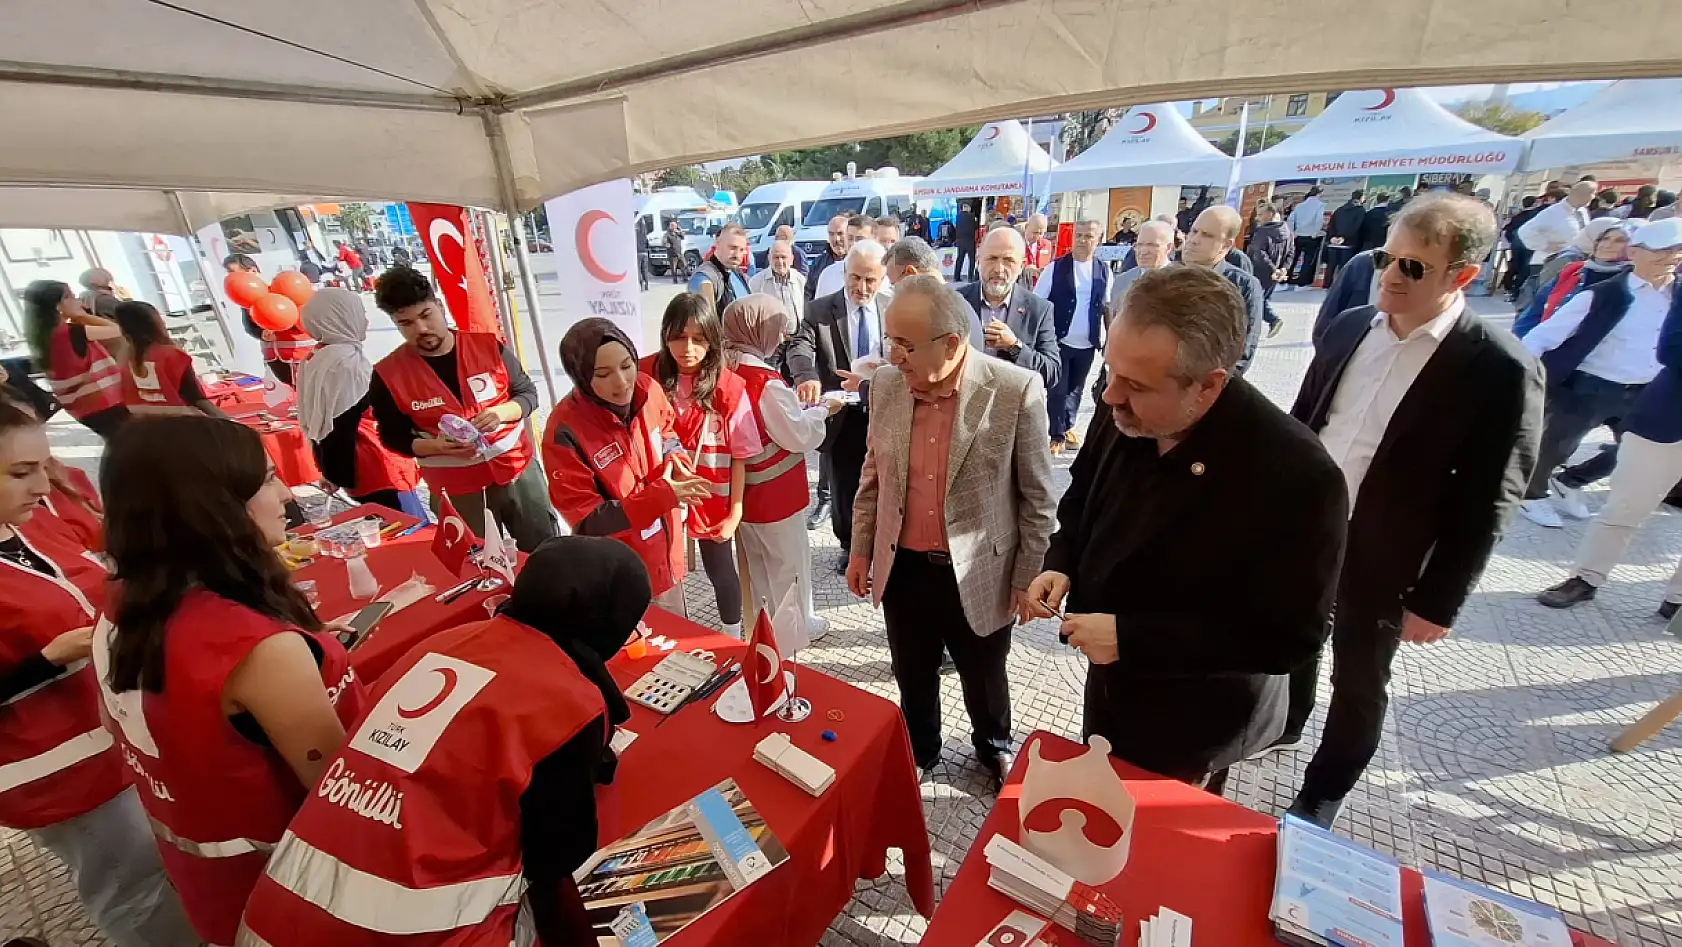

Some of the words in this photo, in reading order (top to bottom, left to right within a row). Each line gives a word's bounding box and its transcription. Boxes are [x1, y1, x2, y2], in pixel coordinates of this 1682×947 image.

[1296, 161, 1345, 172] SAMSUN
[1347, 160, 1358, 170] İL
[1361, 157, 1415, 169] EMNİYET
[1417, 151, 1506, 166] MÜDÜRLÜĞÜ
[368, 728, 410, 752] KIZILAY
[318, 757, 404, 829] Gönüllü
